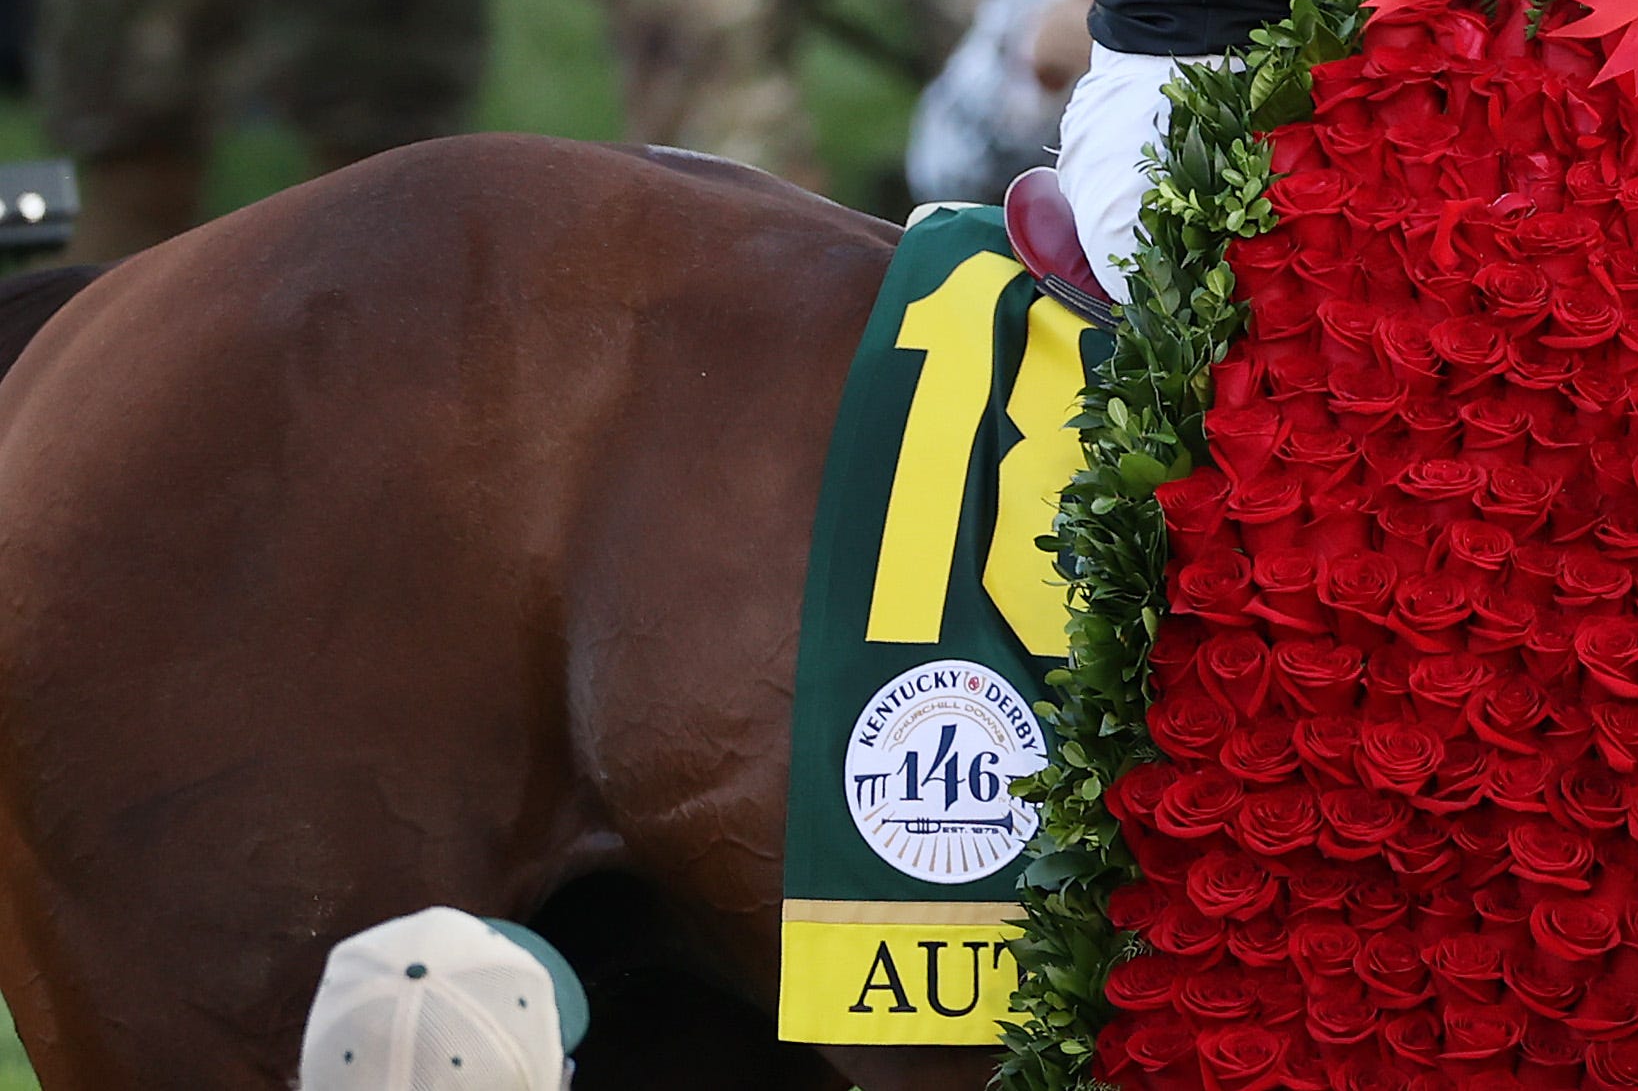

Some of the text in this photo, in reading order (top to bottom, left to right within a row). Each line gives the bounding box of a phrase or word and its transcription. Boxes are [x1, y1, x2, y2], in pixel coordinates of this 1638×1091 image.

[865, 250, 1098, 658] 18
[858, 670, 1039, 751] KENTUCKY DERBY
[893, 701, 1006, 744] CHURCHILL DOWNS
[895, 724, 1000, 812] 146
